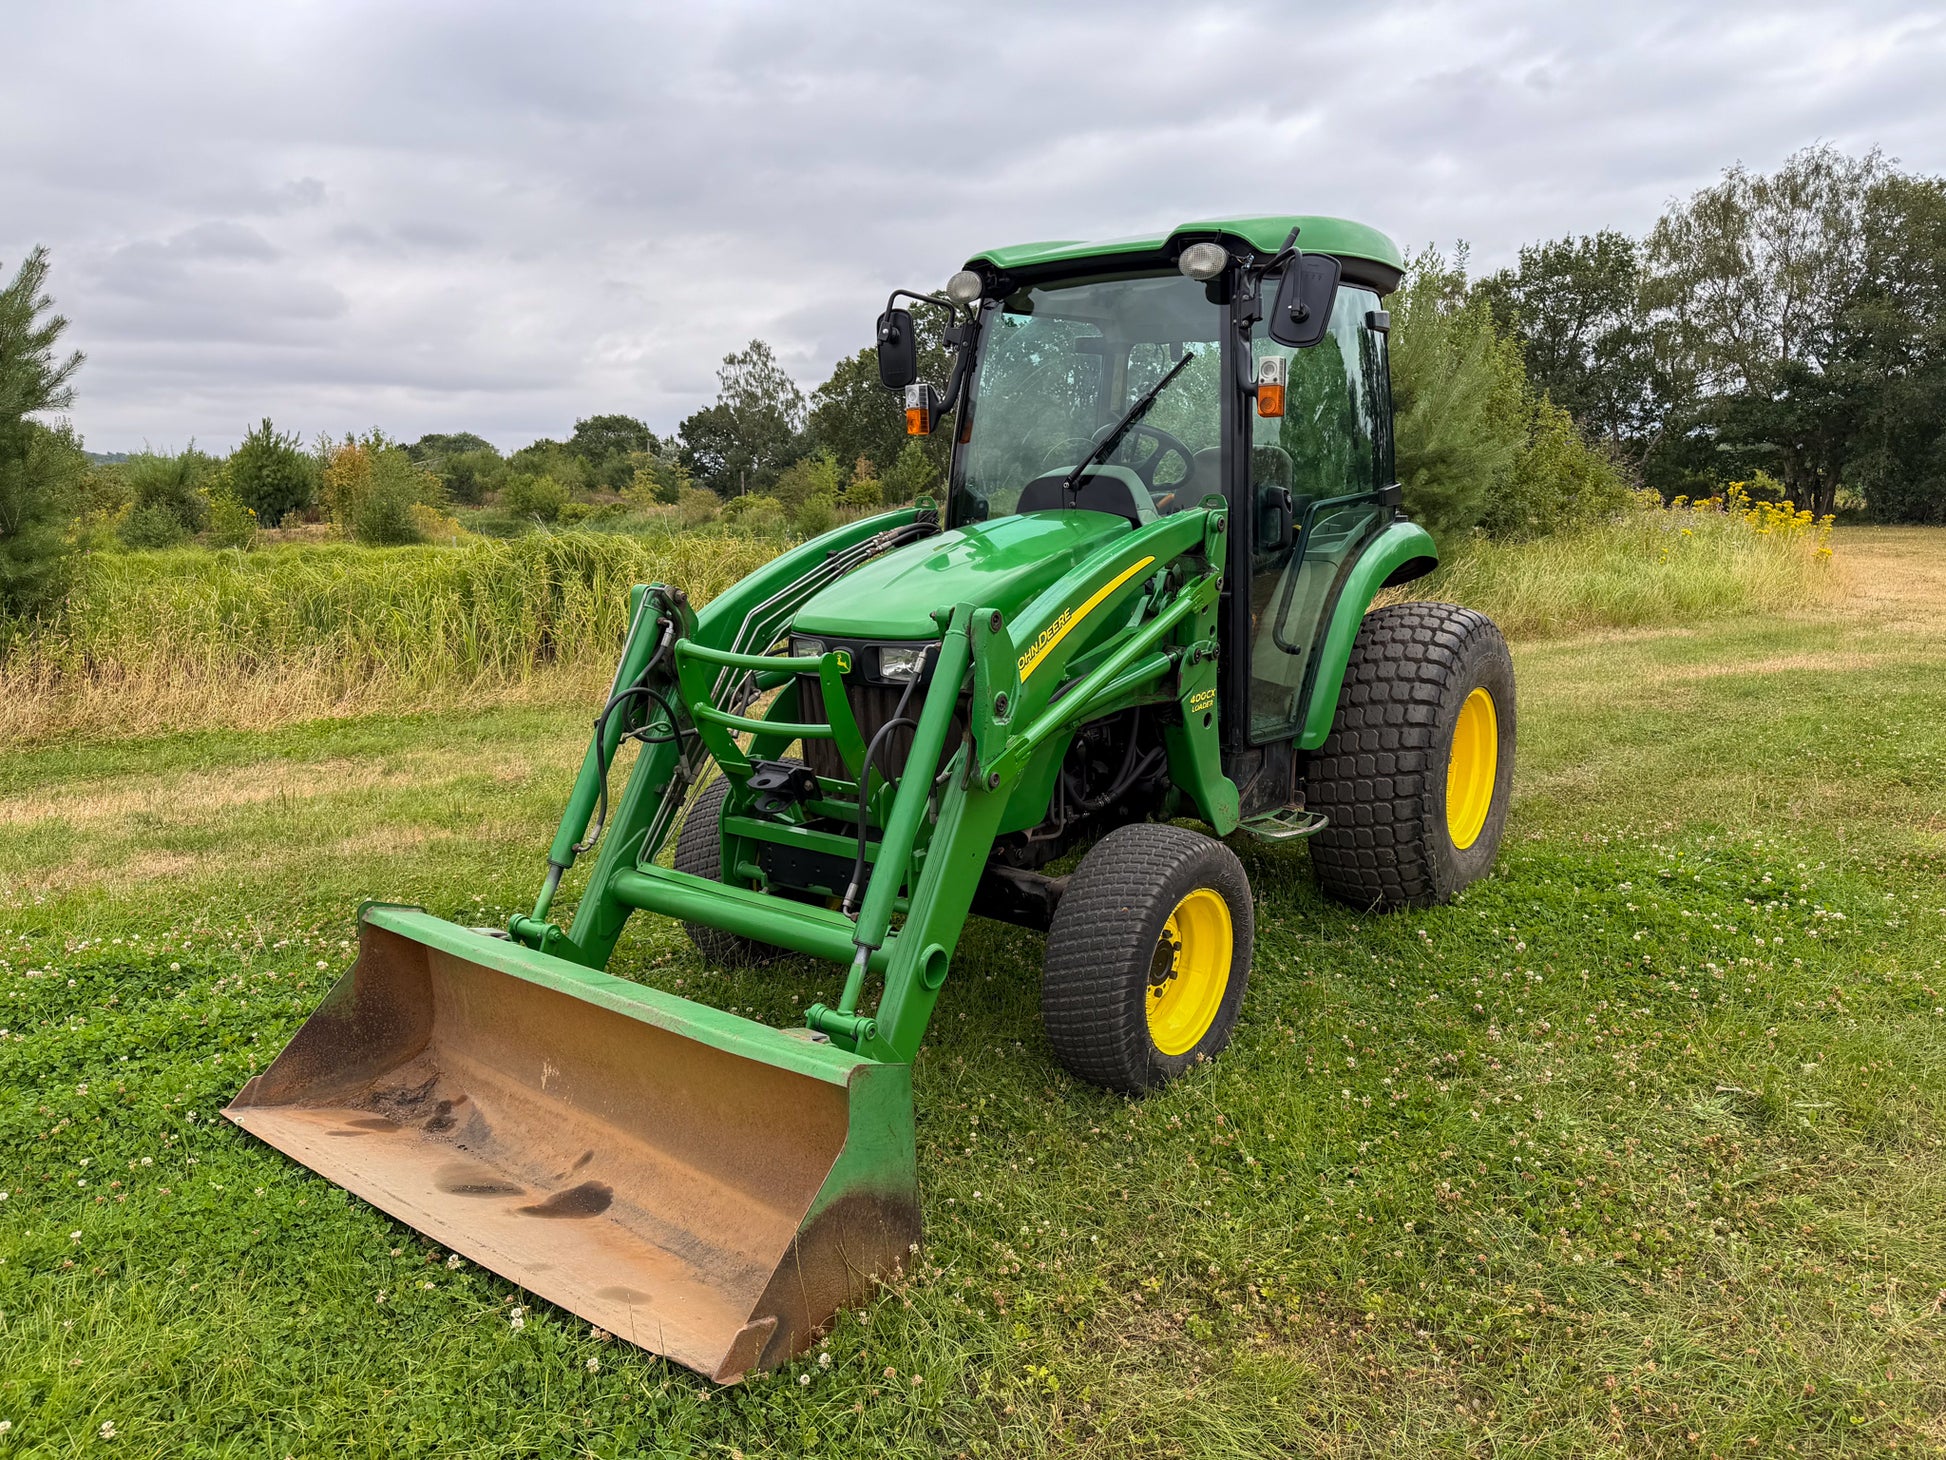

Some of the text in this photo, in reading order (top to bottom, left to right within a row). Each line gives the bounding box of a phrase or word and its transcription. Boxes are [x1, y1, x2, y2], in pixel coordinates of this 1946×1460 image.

[1017, 607, 1072, 670] OHN DEERE
[1190, 688, 1216, 704] 400CX
[1191, 699, 1214, 713] LOADER
